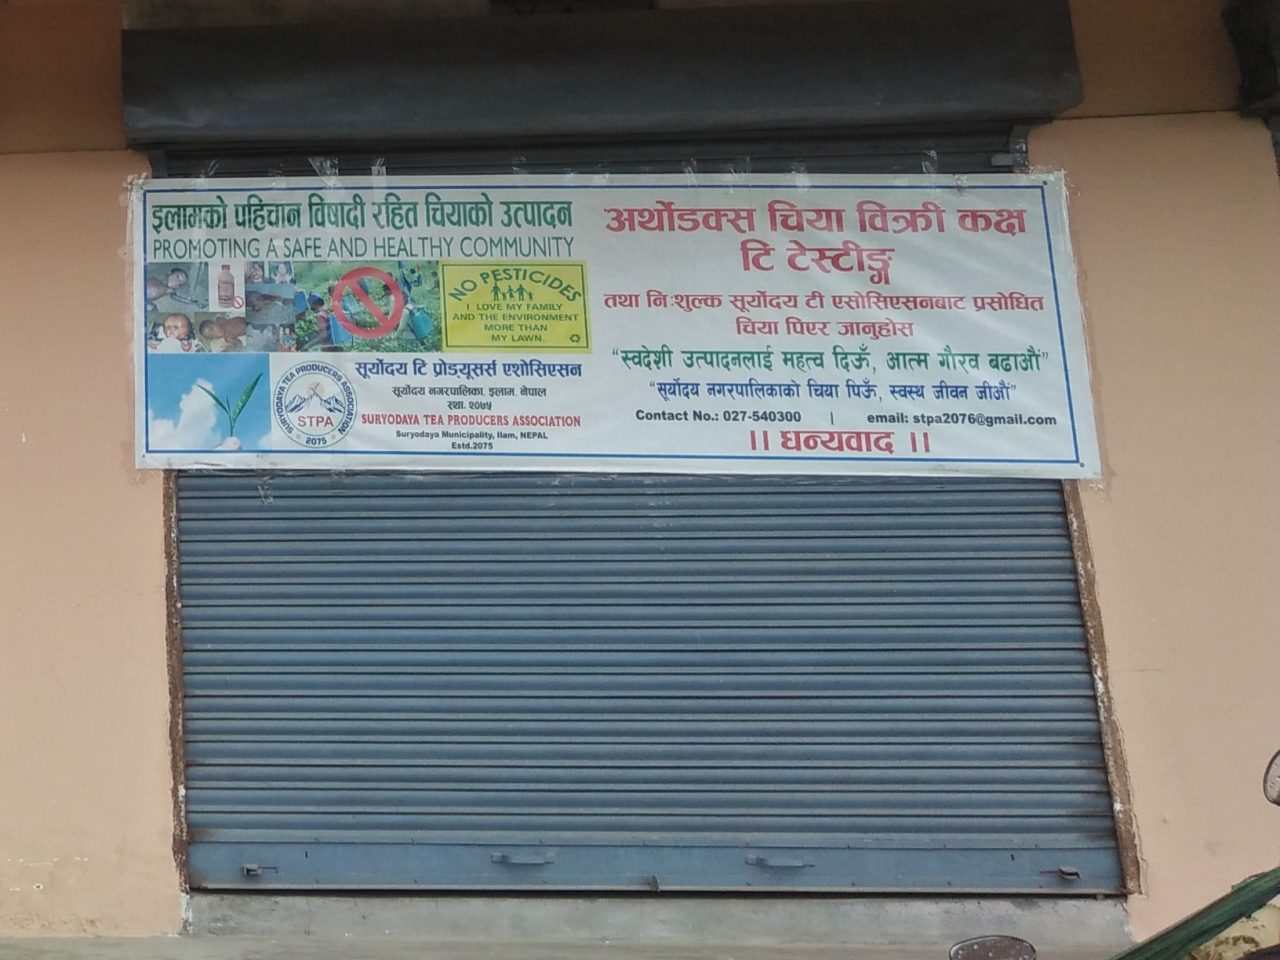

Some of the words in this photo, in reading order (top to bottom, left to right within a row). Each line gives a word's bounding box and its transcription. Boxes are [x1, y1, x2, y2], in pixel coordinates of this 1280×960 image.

[151, 195, 228, 234] इलामको
[234, 193, 302, 232] पहिचान
[308, 192, 366, 230] विषादी
[371, 192, 419, 230] रहित
[425, 191, 494, 228] चियाको
[500, 200, 573, 229] उत्पादन
[603, 199, 756, 234] अर्थोडक्स
[768, 199, 845, 232] चिया
[856, 199, 946, 234] विक्री
[957, 208, 1027, 237] कक्ष
[153, 238, 260, 259] PROMOTING
[266, 238, 279, 258] A
[283, 237, 322, 258] SAFE
[327, 237, 368, 258] AND
[374, 237, 454, 257] HEALTHY
[460, 236, 574, 257] COMMUNITY
[740, 238, 775, 271] टि
[448, 279, 478, 302] NO
[480, 268, 582, 302] PESTICIDES
[476, 303, 503, 311] LOVE
[506, 303, 522, 311] MY
[526, 303, 563, 311] FAMILY
[603, 293, 640, 309] तथा
[729, 290, 798, 312] सूर्योदय
[805, 290, 825, 309] टी
[831, 290, 966, 311] एसोसिएसनबाट
[972, 291, 1044, 311] प्रसोधित
[452, 313, 475, 321] AND
[478, 313, 499, 321] THE
[502, 313, 579, 322] ENVIRONMENT
[484, 323, 515, 332] MORE
[518, 323, 548, 332] THAN
[736, 316, 779, 335] चिया
[785, 316, 831, 336] पिएर
[837, 318, 914, 340] जानुहोस
[491, 335, 508, 343] MY
[355, 358, 408, 379] सूर्योदय
[413, 358, 428, 376] टि
[502, 358, 583, 378] एशोसिएसन
[681, 345, 774, 371] उत्पादनलाई
[886, 351, 930, 370] आत्म
[937, 344, 981, 374] गौरव
[282, 372, 296, 387] TEA
[295, 363, 343, 382] PRODUCERS
[392, 384, 426, 398] सूर्योदय
[520, 385, 547, 397] नेपाल
[706, 377, 801, 400] नगरपालिकाको
[807, 378, 839, 399] चिया
[889, 384, 925, 402] स्वस्थ
[932, 380, 969, 400] जीवन
[275, 385, 294, 434] SURYODAYA
[337, 381, 354, 436] ASSOCIATION
[635, 409, 689, 422] Contact
[693, 410, 719, 422] No.:
[723, 410, 802, 423] 027-540300
[867, 411, 909, 424] email:
[912, 412, 1057, 427] stpa2076@gmail.com
[297, 415, 334, 428] STPA
[361, 413, 420, 425] SURYODAYA
[423, 414, 444, 425] TEA
[447, 414, 509, 426] PRODUCERS
[512, 415, 581, 427] ASSOCIATION
[305, 436, 327, 445] 2075
[395, 430, 439, 439] Suryodaya
[441, 431, 495, 440] Municipality,
[497, 431, 518, 440] Ilam,
[520, 431, 548, 439] NEPAL
[780, 430, 895, 454] धन्यवाद
